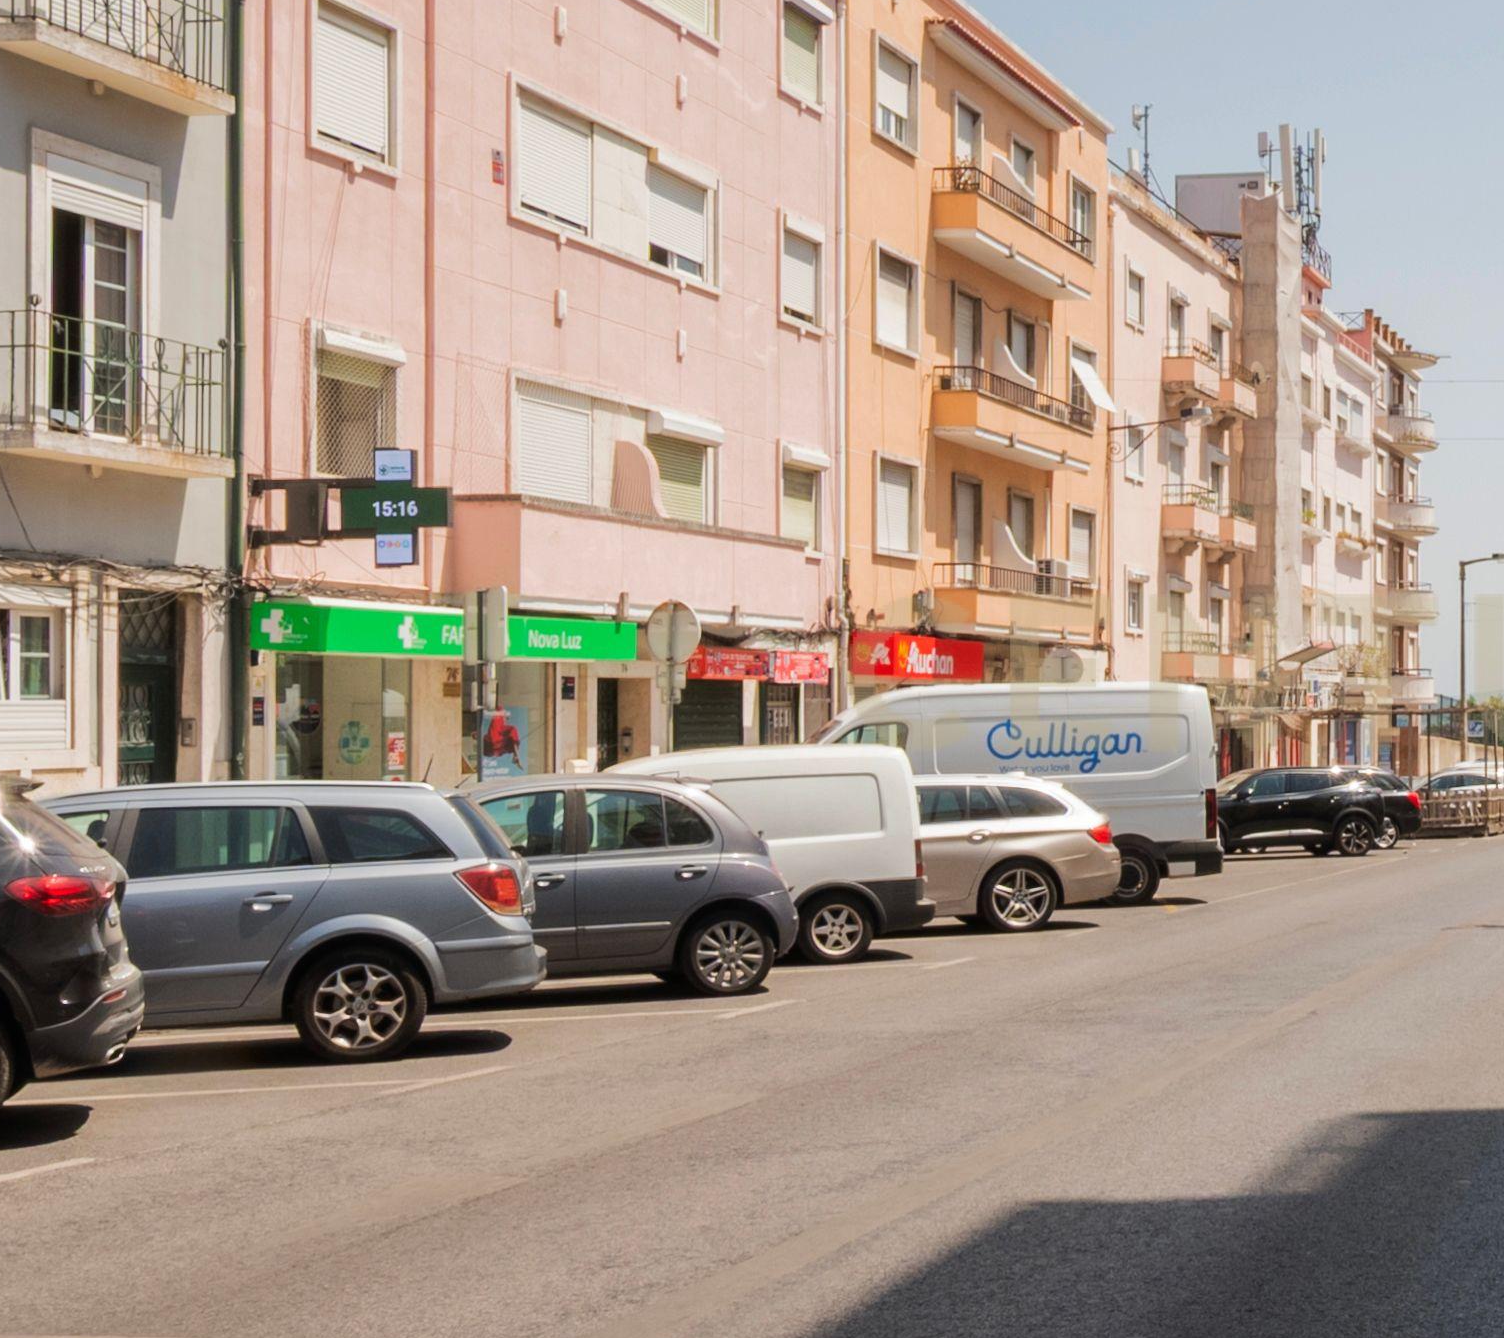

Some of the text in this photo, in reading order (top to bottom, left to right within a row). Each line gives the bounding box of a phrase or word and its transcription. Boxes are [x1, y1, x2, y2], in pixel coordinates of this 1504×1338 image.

[372, 500, 418, 517] 15:16
[528, 631, 558, 649] Nova
[560, 633, 582, 650] Luz
[906, 640, 955, 674] Auchan
[987, 717, 1142, 774] Culligan
